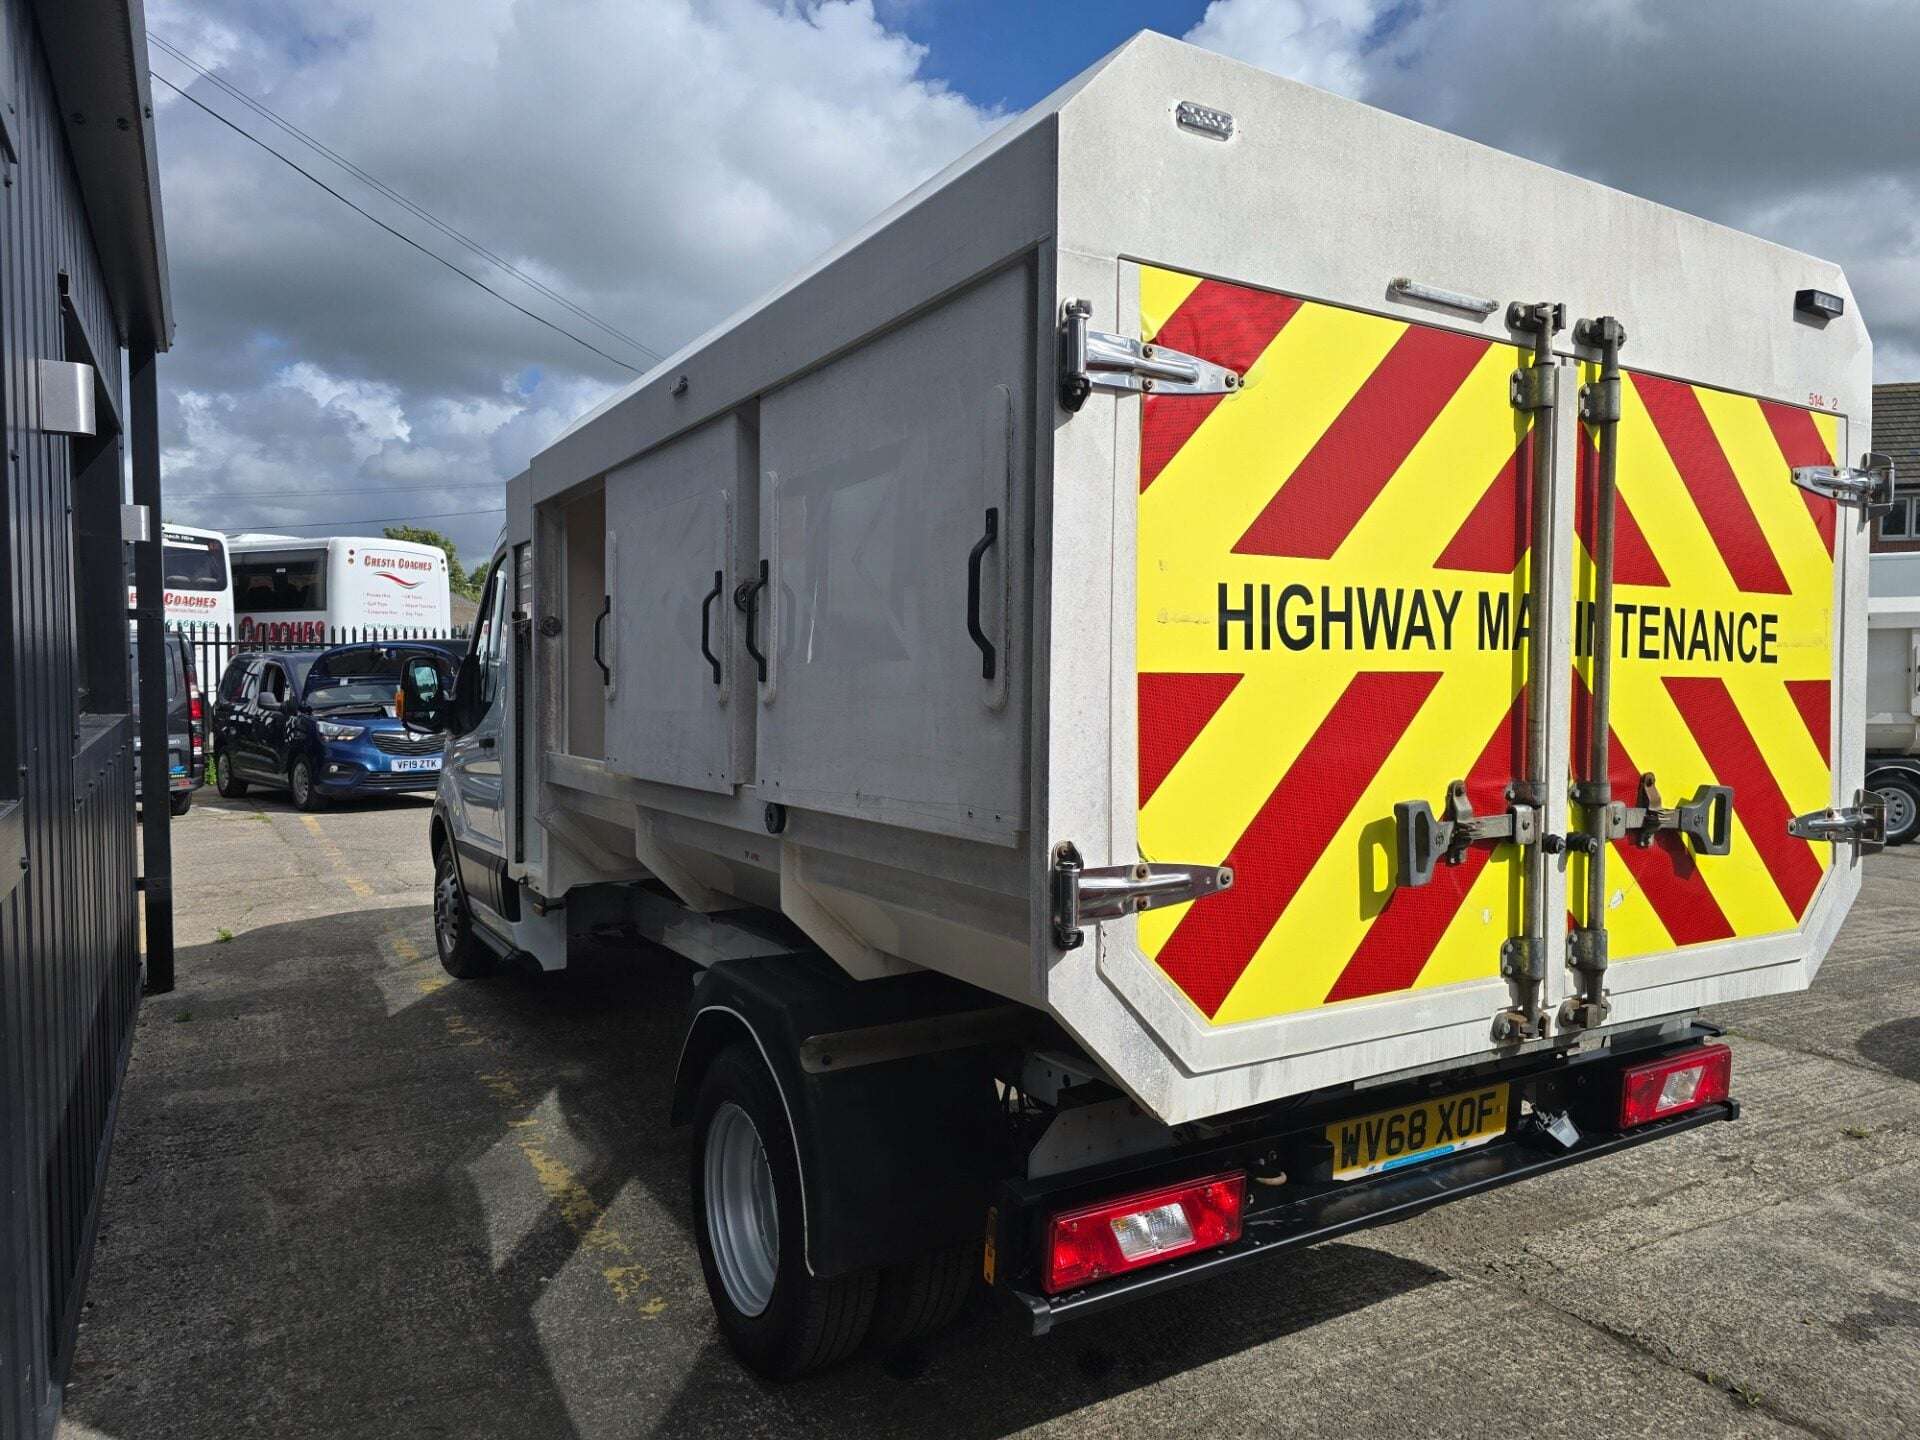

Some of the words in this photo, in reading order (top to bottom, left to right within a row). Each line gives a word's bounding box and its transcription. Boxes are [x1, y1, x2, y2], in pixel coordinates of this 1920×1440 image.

[1217, 582, 1463, 651] HIGHWAY
[1340, 1108, 1428, 1169] WV68
[1436, 1091, 1497, 1145] XOF
